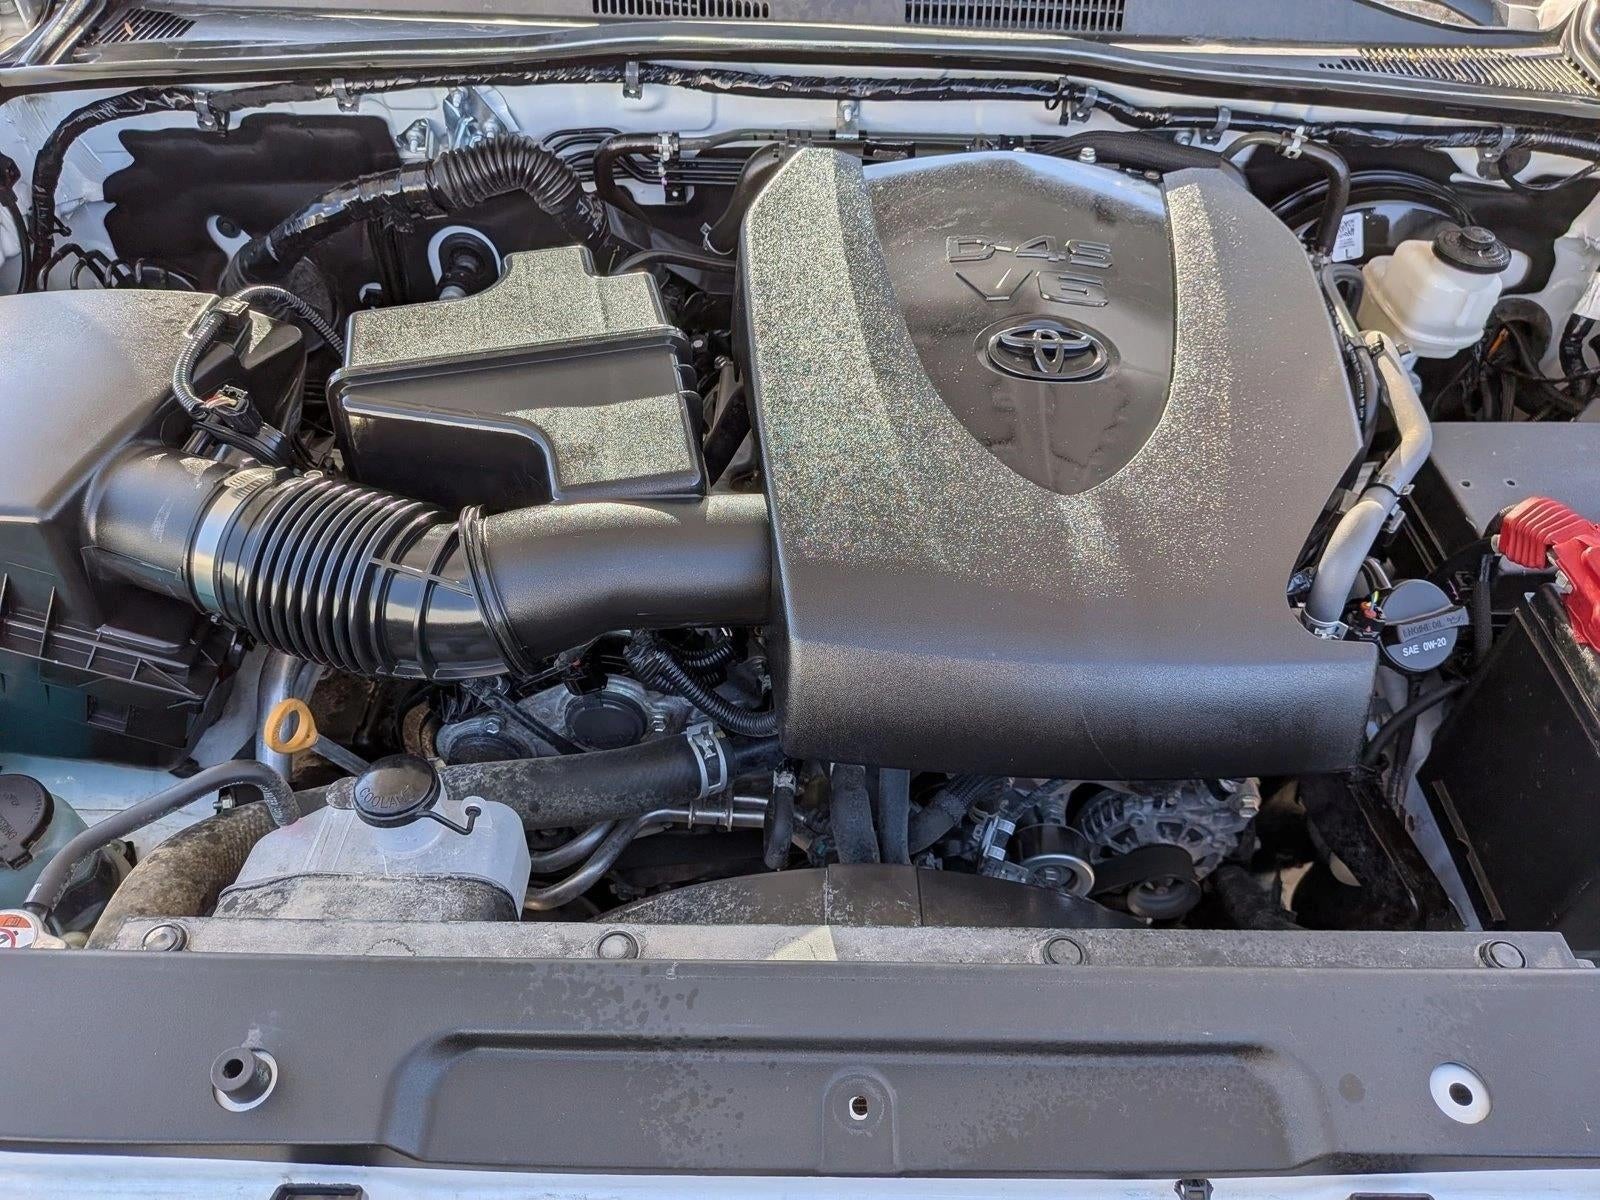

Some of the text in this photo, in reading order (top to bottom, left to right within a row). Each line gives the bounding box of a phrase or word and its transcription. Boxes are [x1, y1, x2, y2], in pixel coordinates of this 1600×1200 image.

[955, 266, 1109, 307] V6
[1402, 637, 1447, 656] SAE 0W-20
